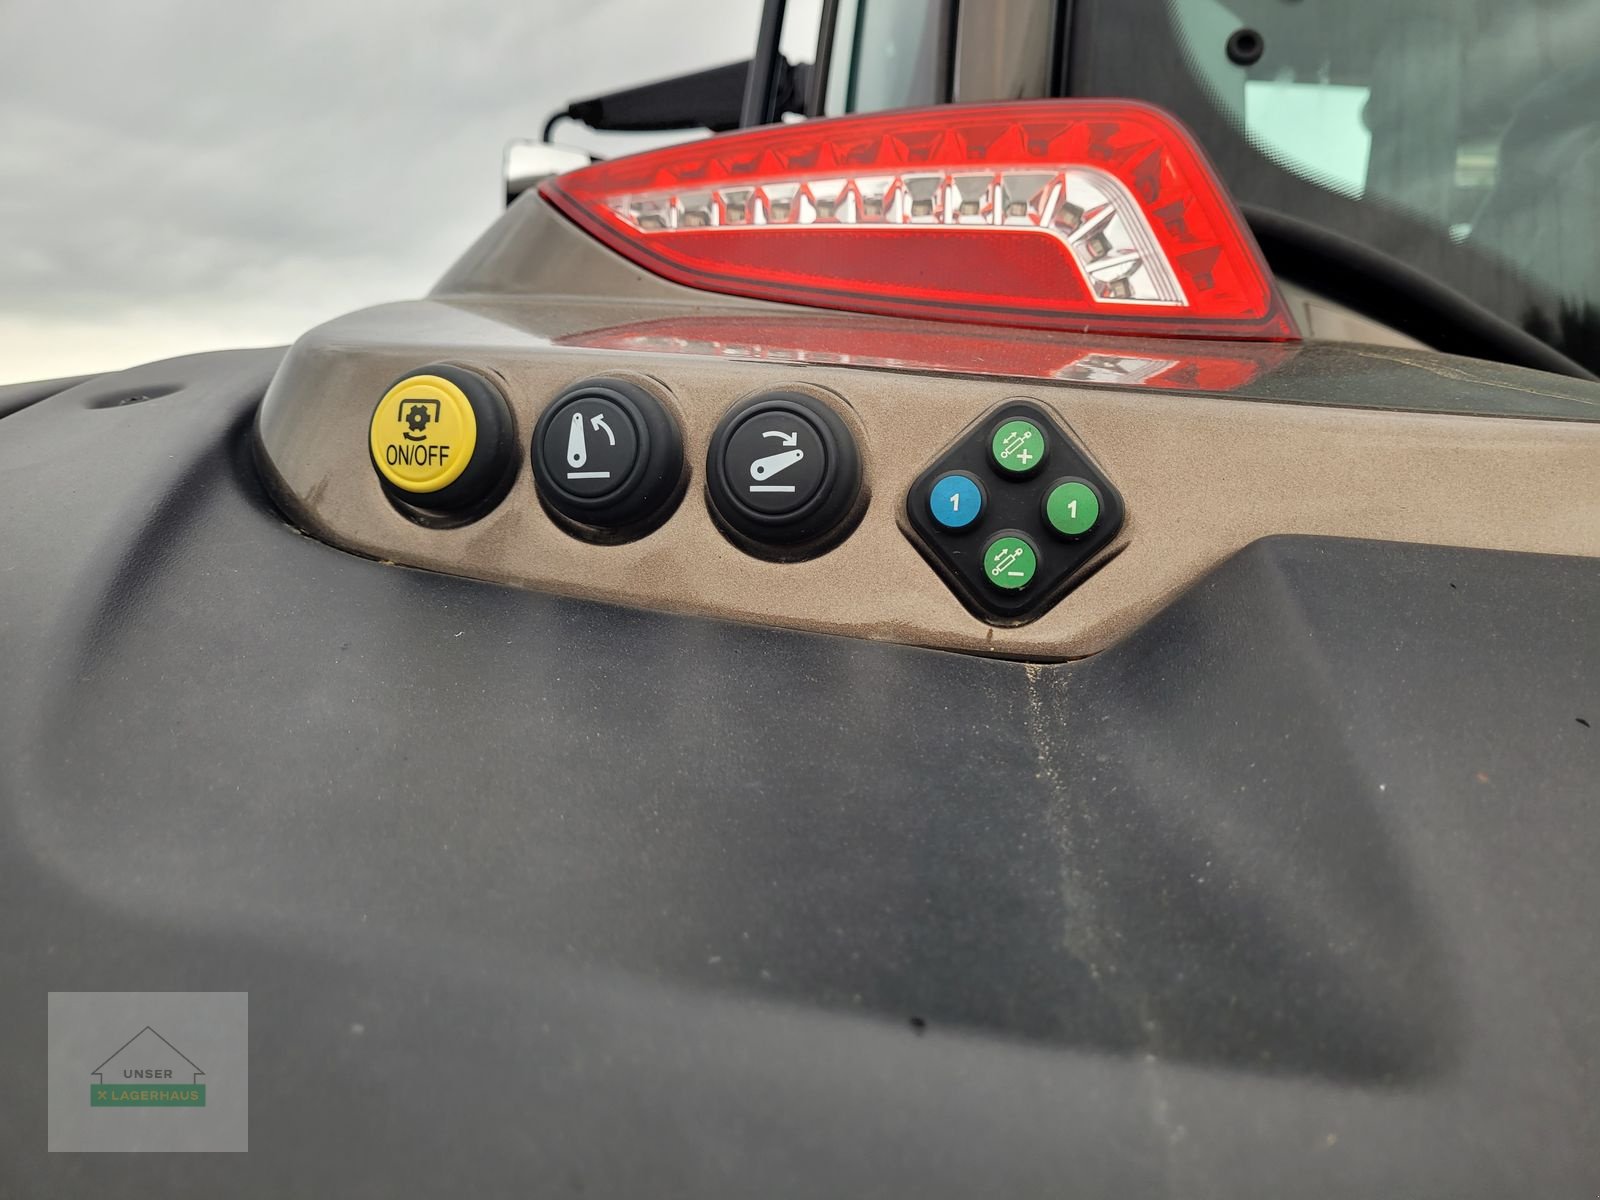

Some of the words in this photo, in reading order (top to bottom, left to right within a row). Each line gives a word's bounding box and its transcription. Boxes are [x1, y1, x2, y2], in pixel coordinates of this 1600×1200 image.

[386, 444, 450, 467] ON/OFF
[950, 493, 960, 512] 1
[1067, 500, 1077, 519] 1
